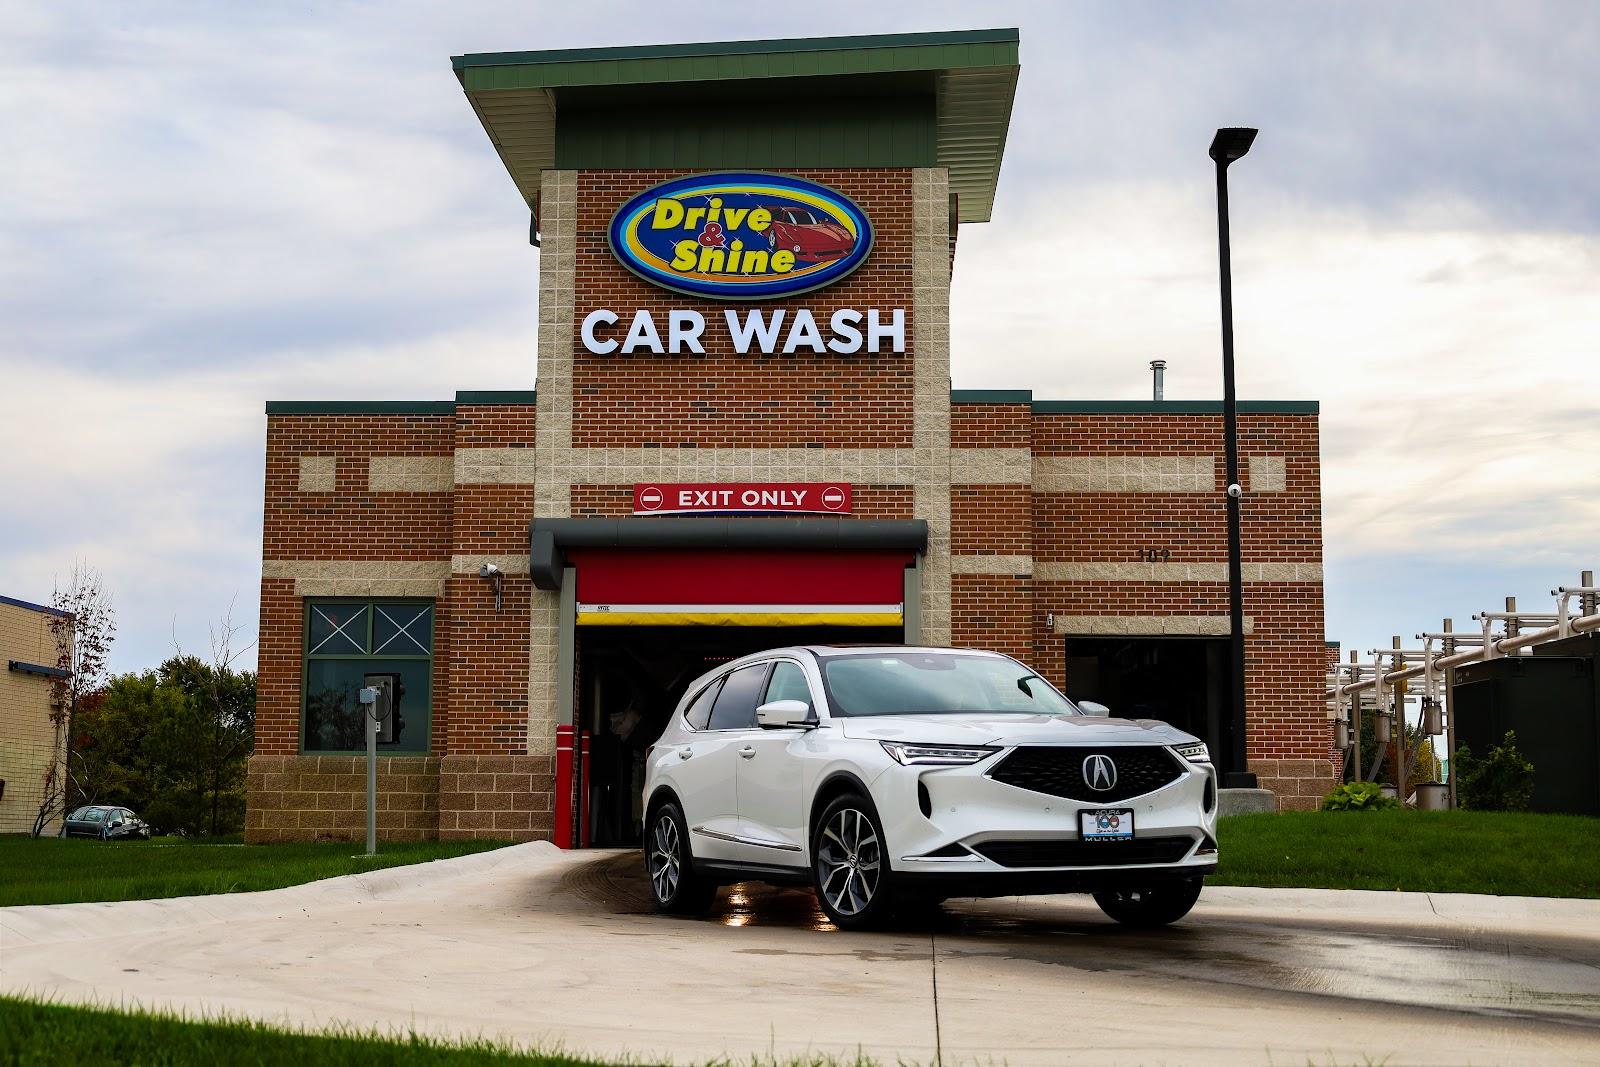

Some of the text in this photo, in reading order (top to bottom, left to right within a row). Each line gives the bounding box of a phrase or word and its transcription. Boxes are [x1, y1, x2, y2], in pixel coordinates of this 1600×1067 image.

[652, 197, 772, 231] Drive
[698, 221, 726, 248] &
[670, 239, 796, 273] Shine
[581, 309, 905, 355] CAR WASH
[678, 490, 807, 506] EXIT ONLY
